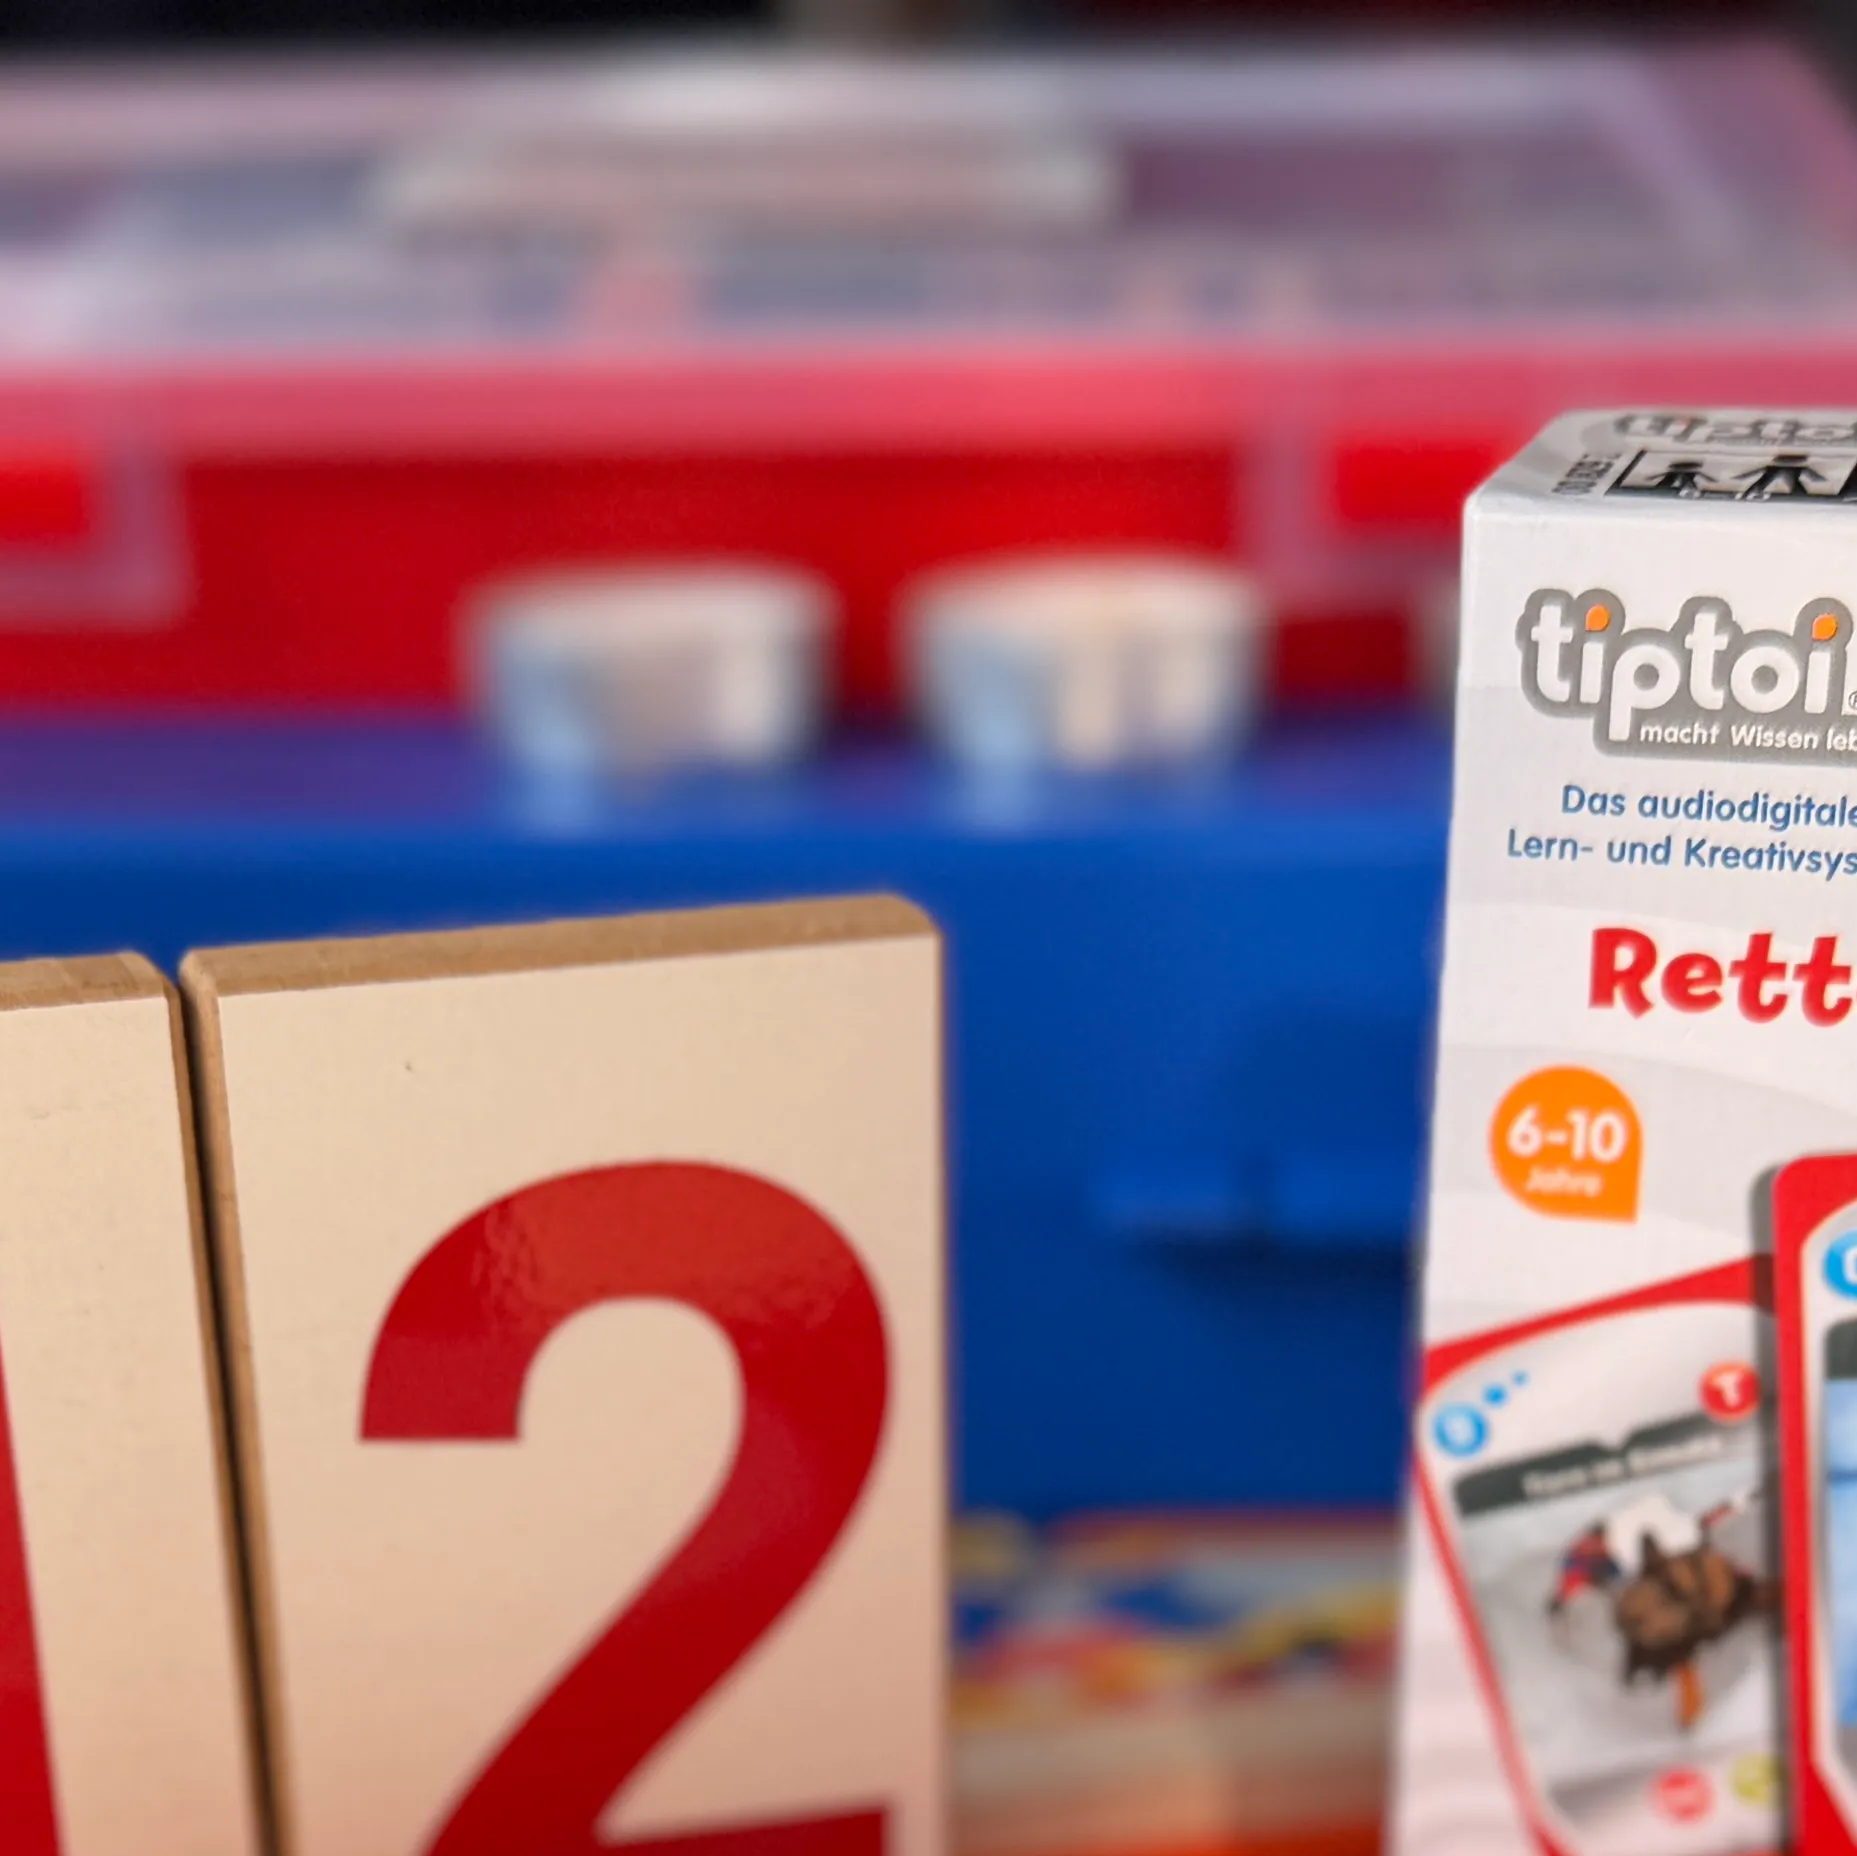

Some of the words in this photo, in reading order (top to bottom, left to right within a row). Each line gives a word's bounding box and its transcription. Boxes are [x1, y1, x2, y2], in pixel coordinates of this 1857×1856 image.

[1530, 602, 1839, 742] tiptoi
[1638, 721, 1719, 746] macht
[1730, 723, 1820, 750] Wissen
[1561, 784, 1626, 817] Das
[1507, 828, 1594, 862] Lern-
[1606, 834, 1672, 867] und
[1505, 1103, 1629, 1164] 6-10
